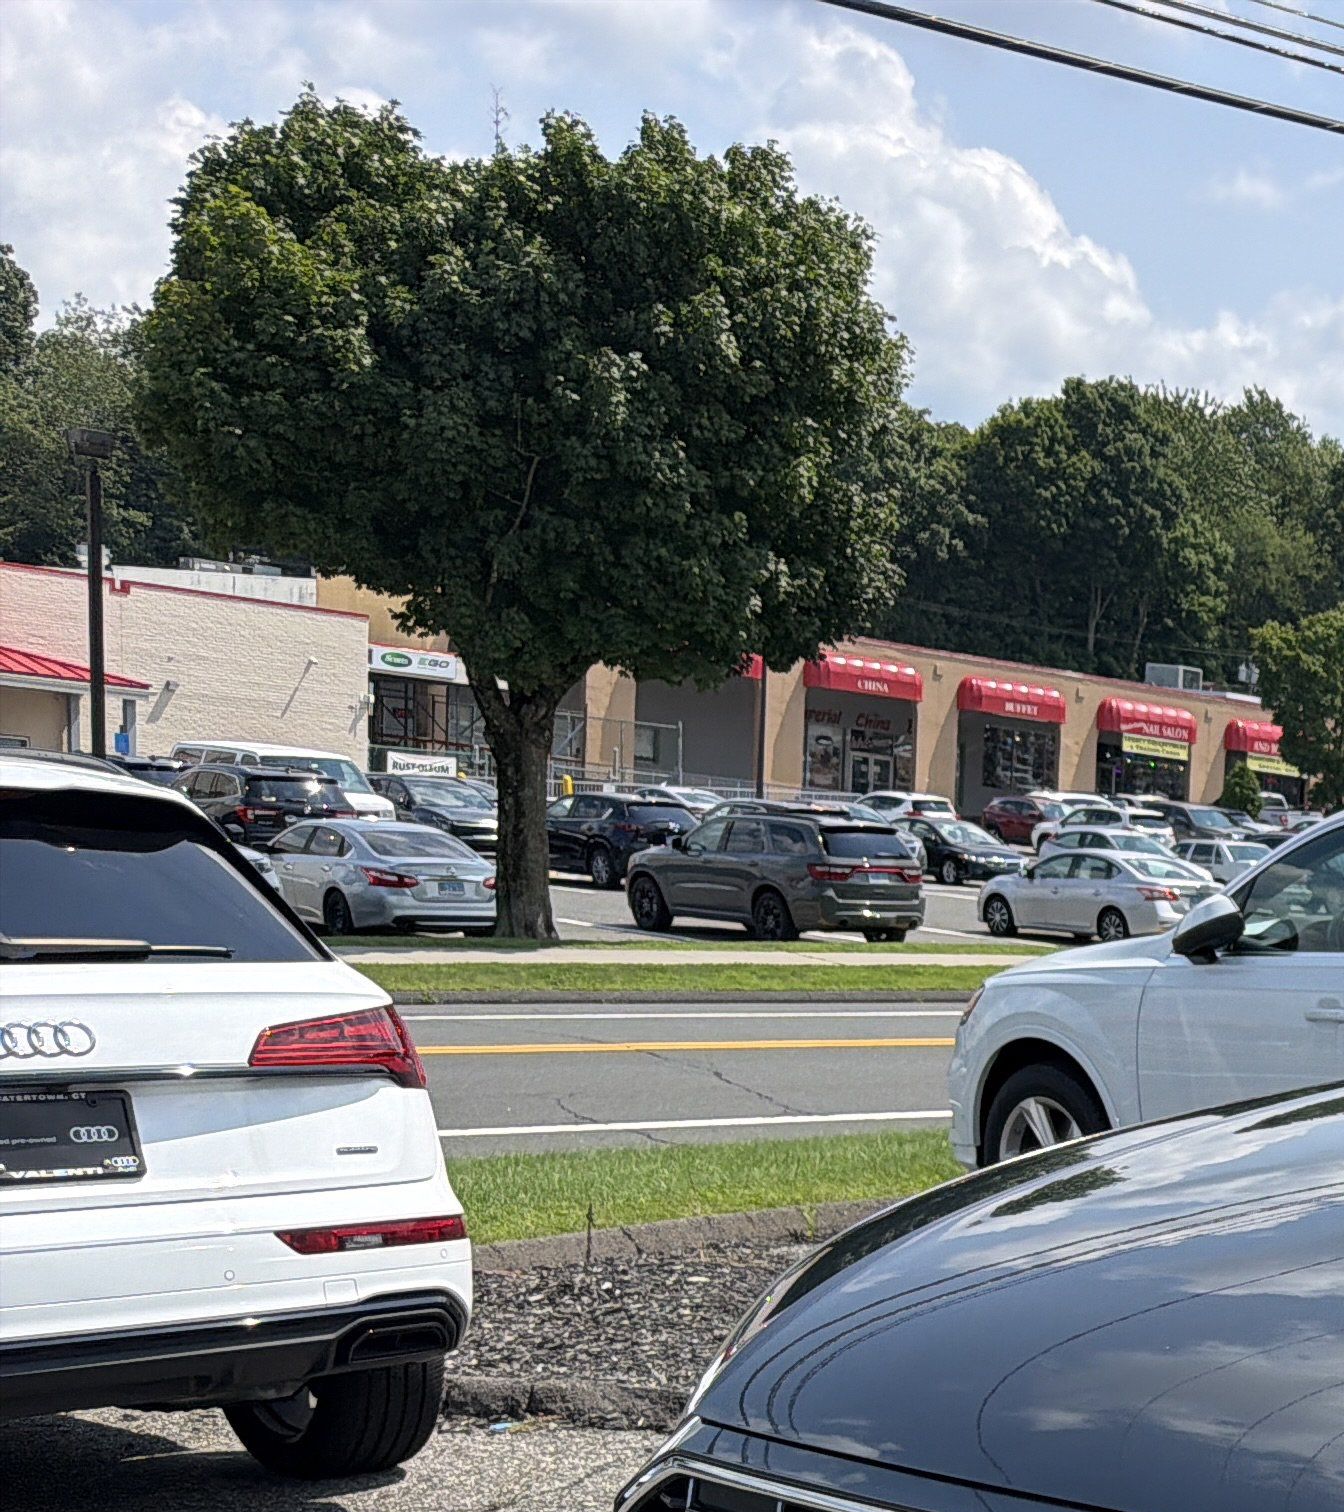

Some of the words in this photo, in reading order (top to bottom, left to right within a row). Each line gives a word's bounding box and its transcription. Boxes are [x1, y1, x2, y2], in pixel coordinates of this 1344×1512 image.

[857, 679, 889, 693] CHINA
[1143, 723, 1161, 737] NAIL
[1162, 726, 1189, 740] SALON
[11, 1136, 56, 1145] pre-owned
[9, 1166, 104, 1179] VALENTI
